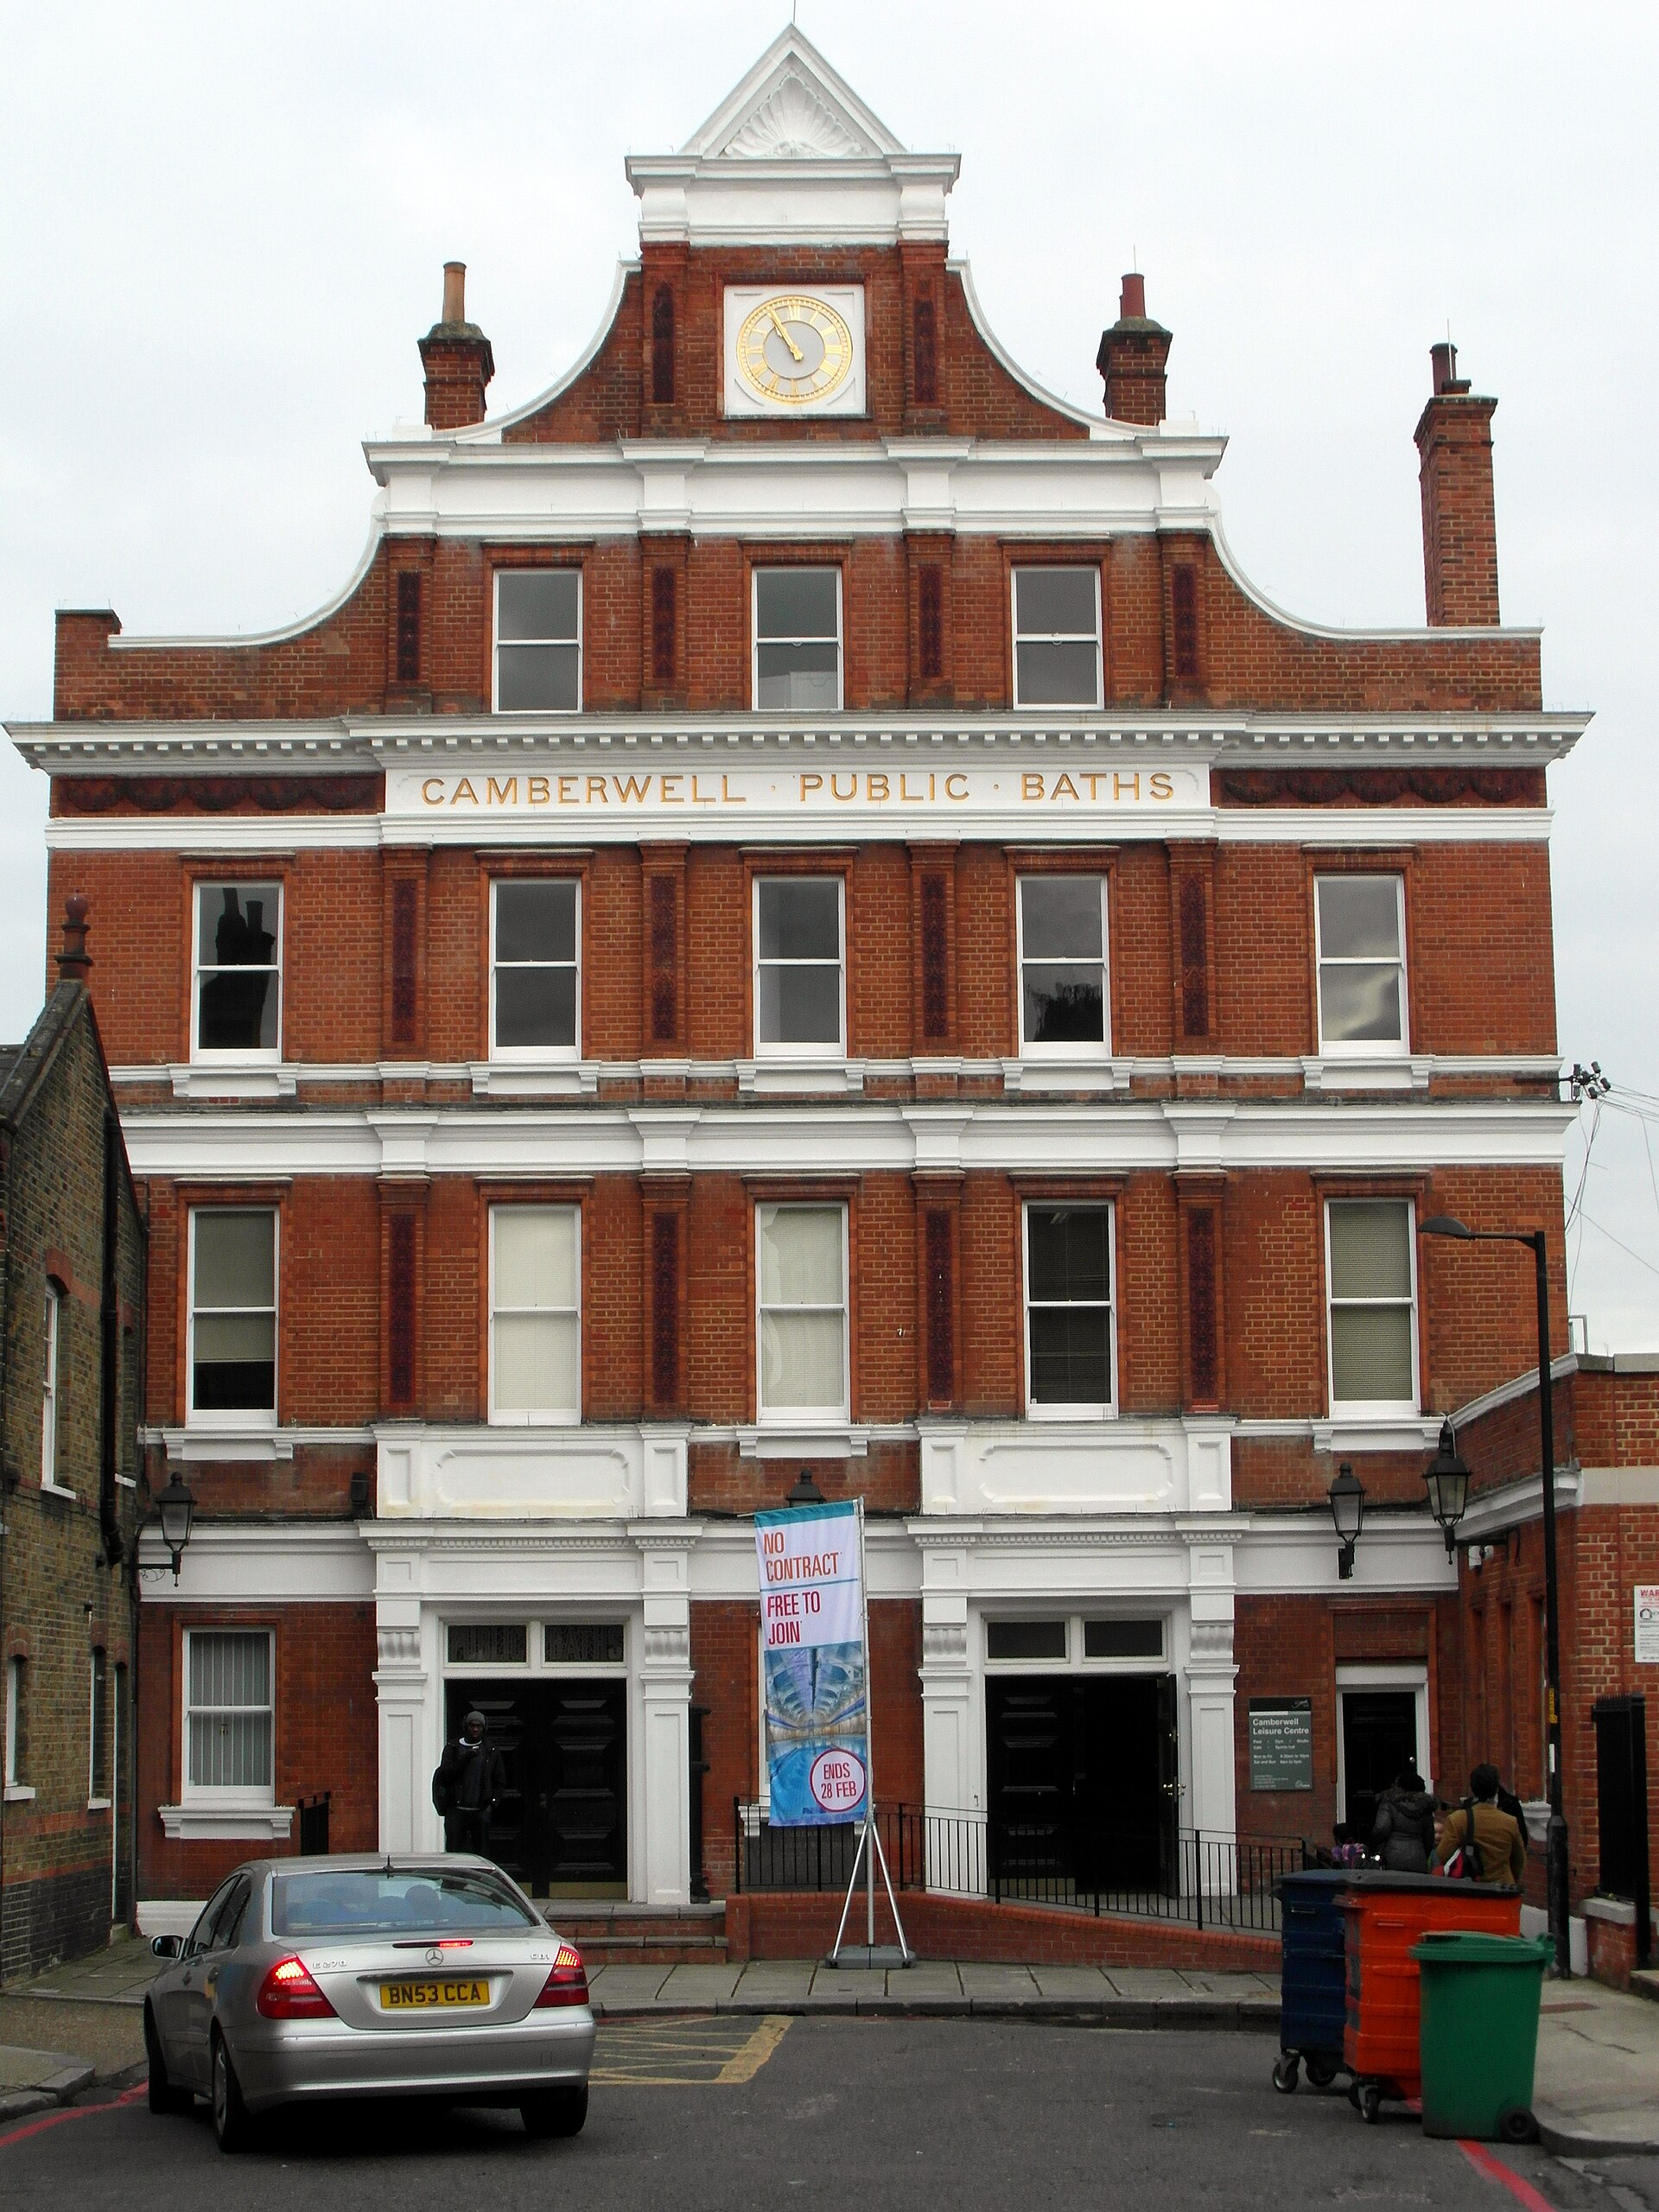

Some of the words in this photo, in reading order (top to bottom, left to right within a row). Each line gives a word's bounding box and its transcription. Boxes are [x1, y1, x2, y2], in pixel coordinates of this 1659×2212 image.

[421, 774, 747, 805] CAMBERWELL
[799, 772, 969, 802] PUBLIC
[1021, 772, 1174, 800] BATHS
[764, 1532, 785, 1554] NO
[766, 1552, 839, 1582] CONTRACT
[767, 1593, 799, 1618] FREE
[802, 1591, 821, 1614] TO
[768, 1621, 800, 1645] JOIN
[823, 1763, 850, 1780] ENDS
[821, 1783, 832, 1799] 28
[836, 1781, 856, 1797] FEB
[389, 1985, 438, 2005] BN53
[444, 1983, 481, 2001] CCA
